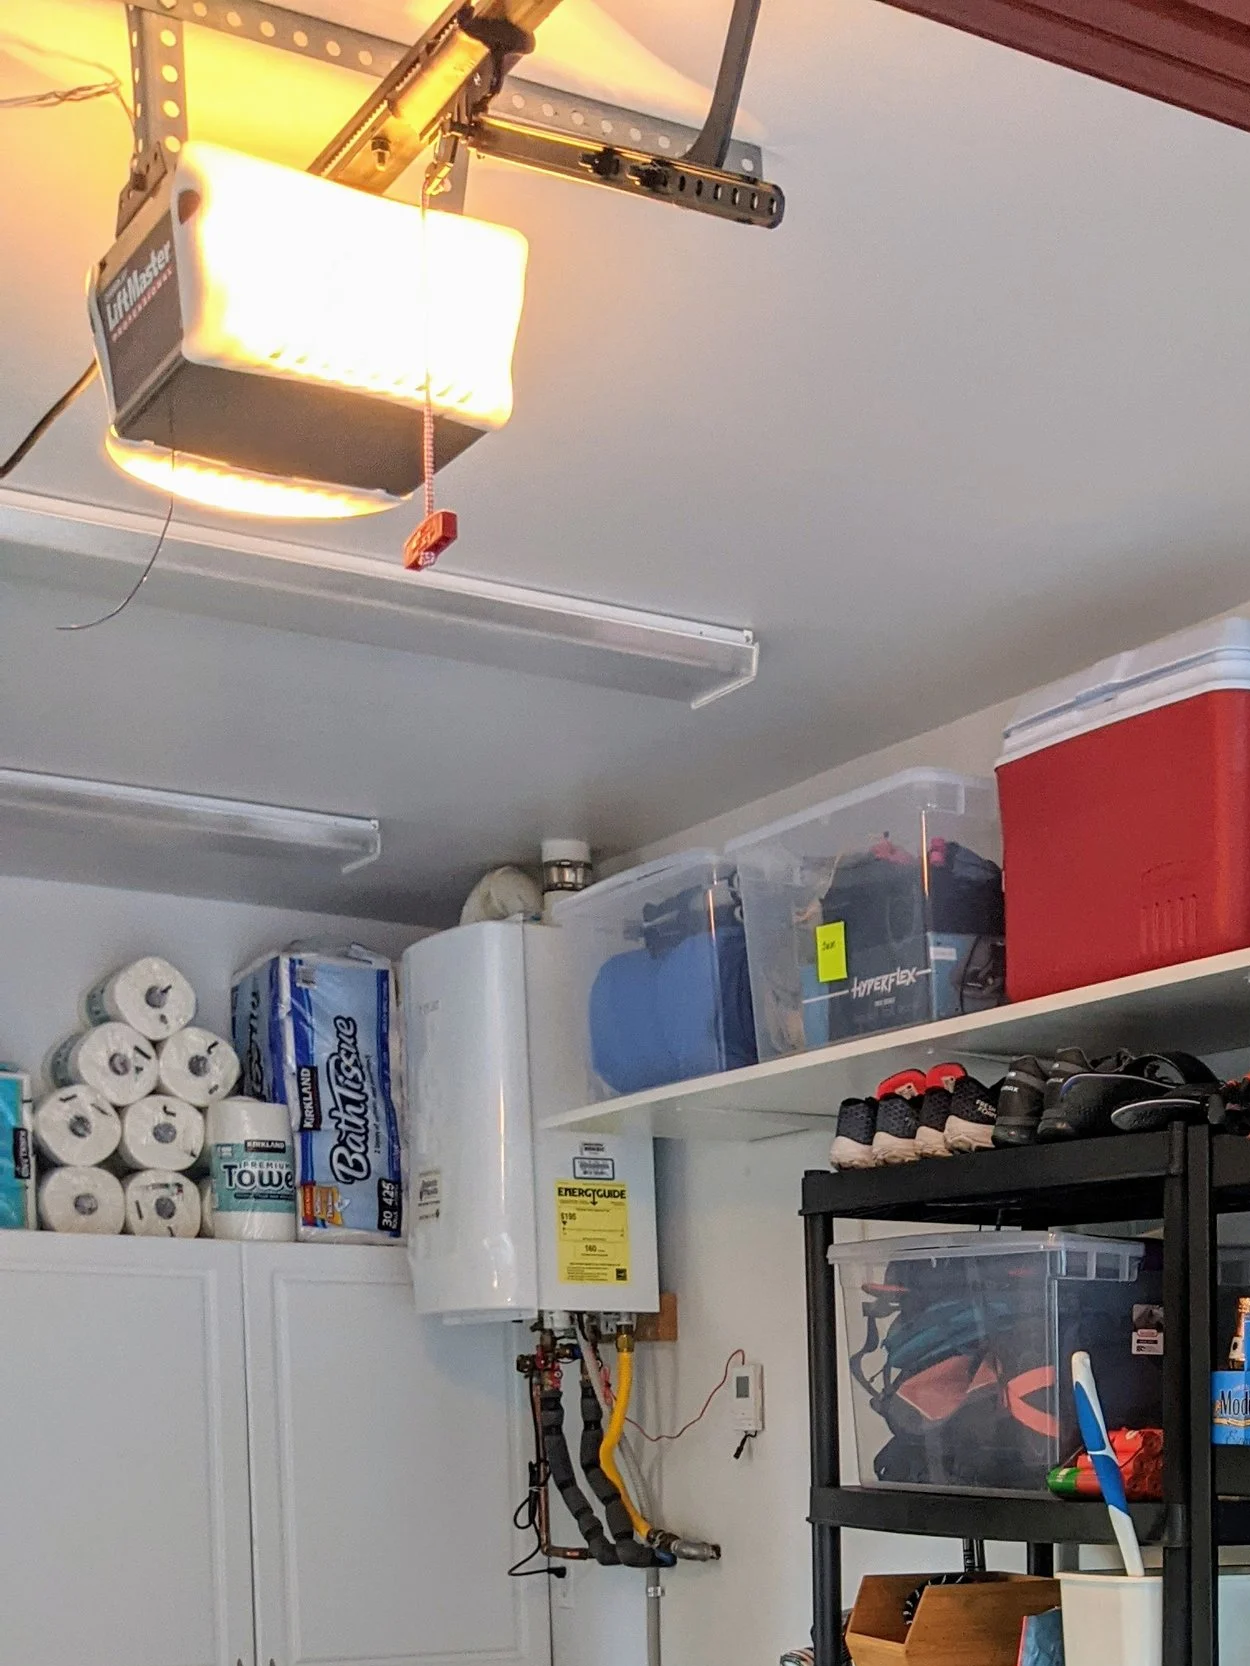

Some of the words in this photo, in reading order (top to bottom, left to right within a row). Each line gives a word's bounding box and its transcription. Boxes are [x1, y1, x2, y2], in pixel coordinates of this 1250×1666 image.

[106, 240, 170, 331] LiftMaster
[851, 966, 917, 999] HYPERFLEX
[303, 1067, 318, 1130] KIRKLAND
[246, 1140, 285, 1149] KIRKLAND
[382, 1181, 396, 1207] 425
[557, 1186, 627, 1201] ENERGYGUIDE
[382, 1210, 393, 1228] 30
